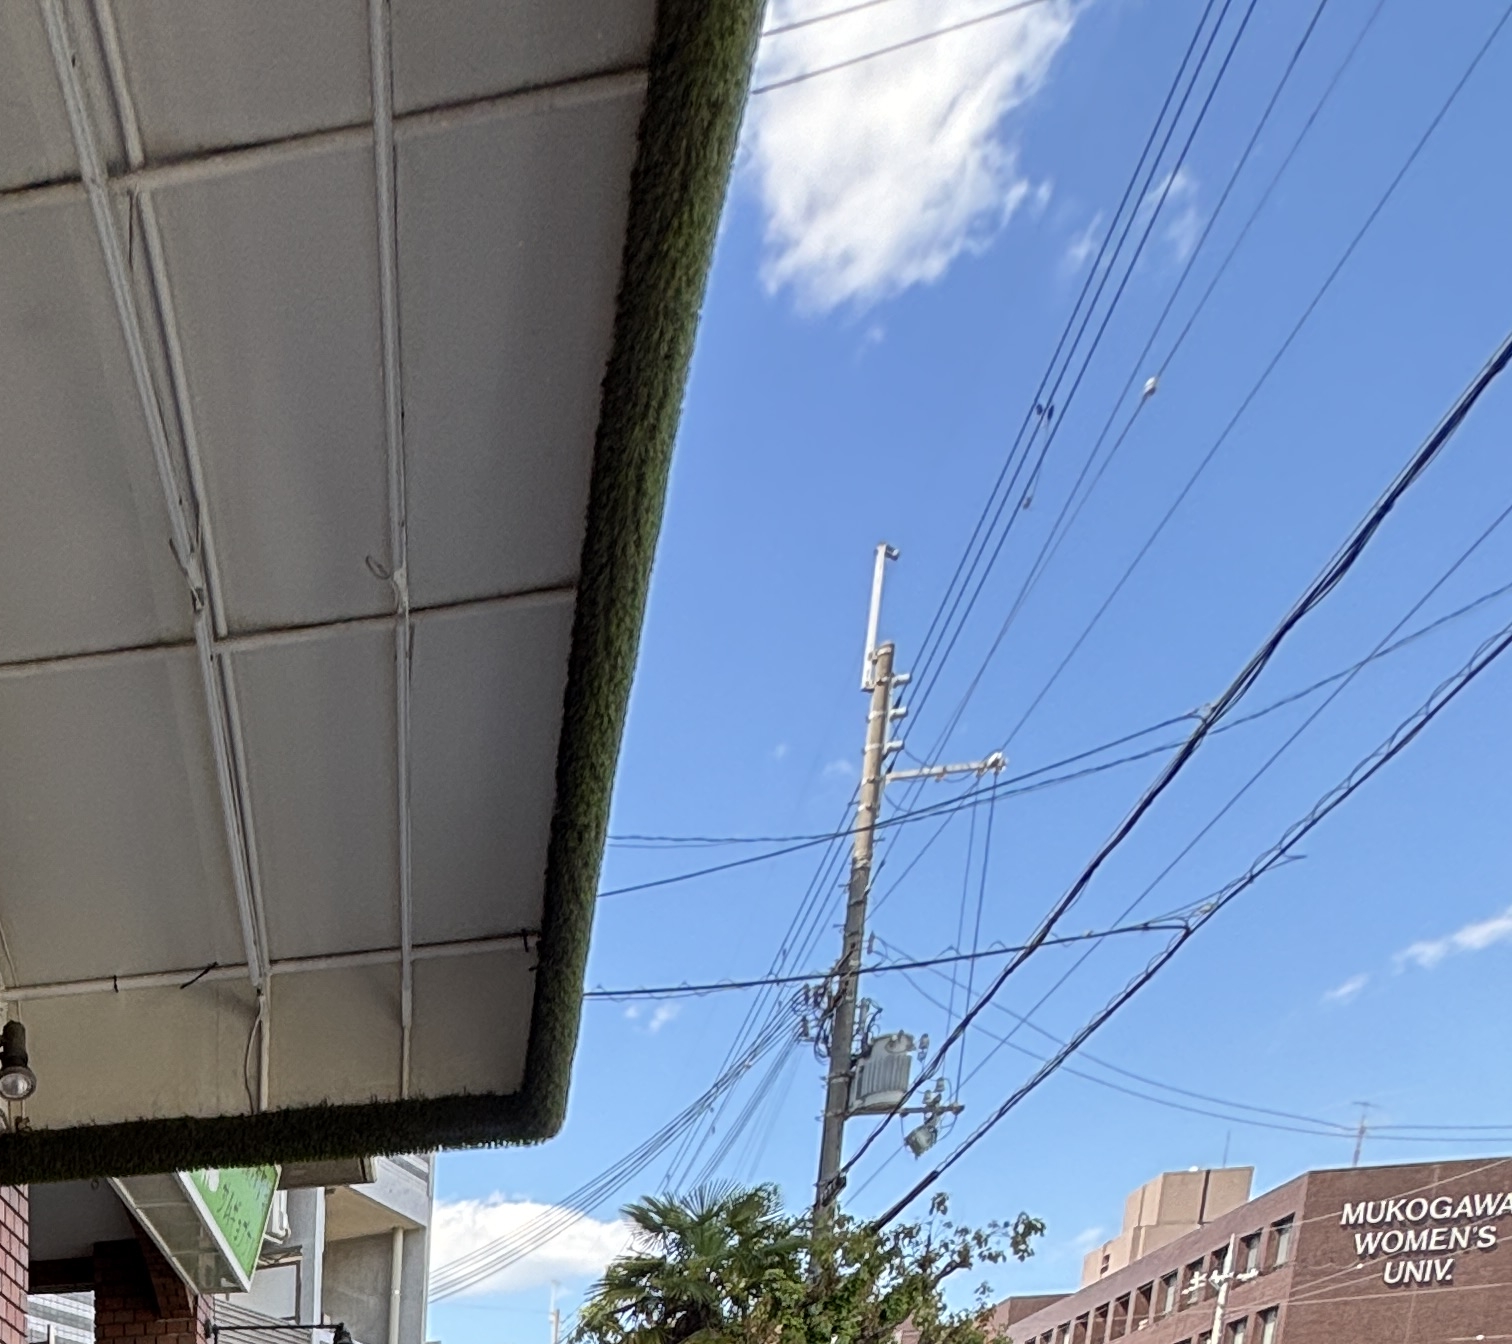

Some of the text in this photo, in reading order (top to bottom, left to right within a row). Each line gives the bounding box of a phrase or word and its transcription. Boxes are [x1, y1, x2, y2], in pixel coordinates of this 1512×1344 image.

[1340, 1192, 1512, 1226] MUKOGAWA
[1354, 1225, 1497, 1256] WOMEN'S
[1383, 1258, 1455, 1284] UNIV.
